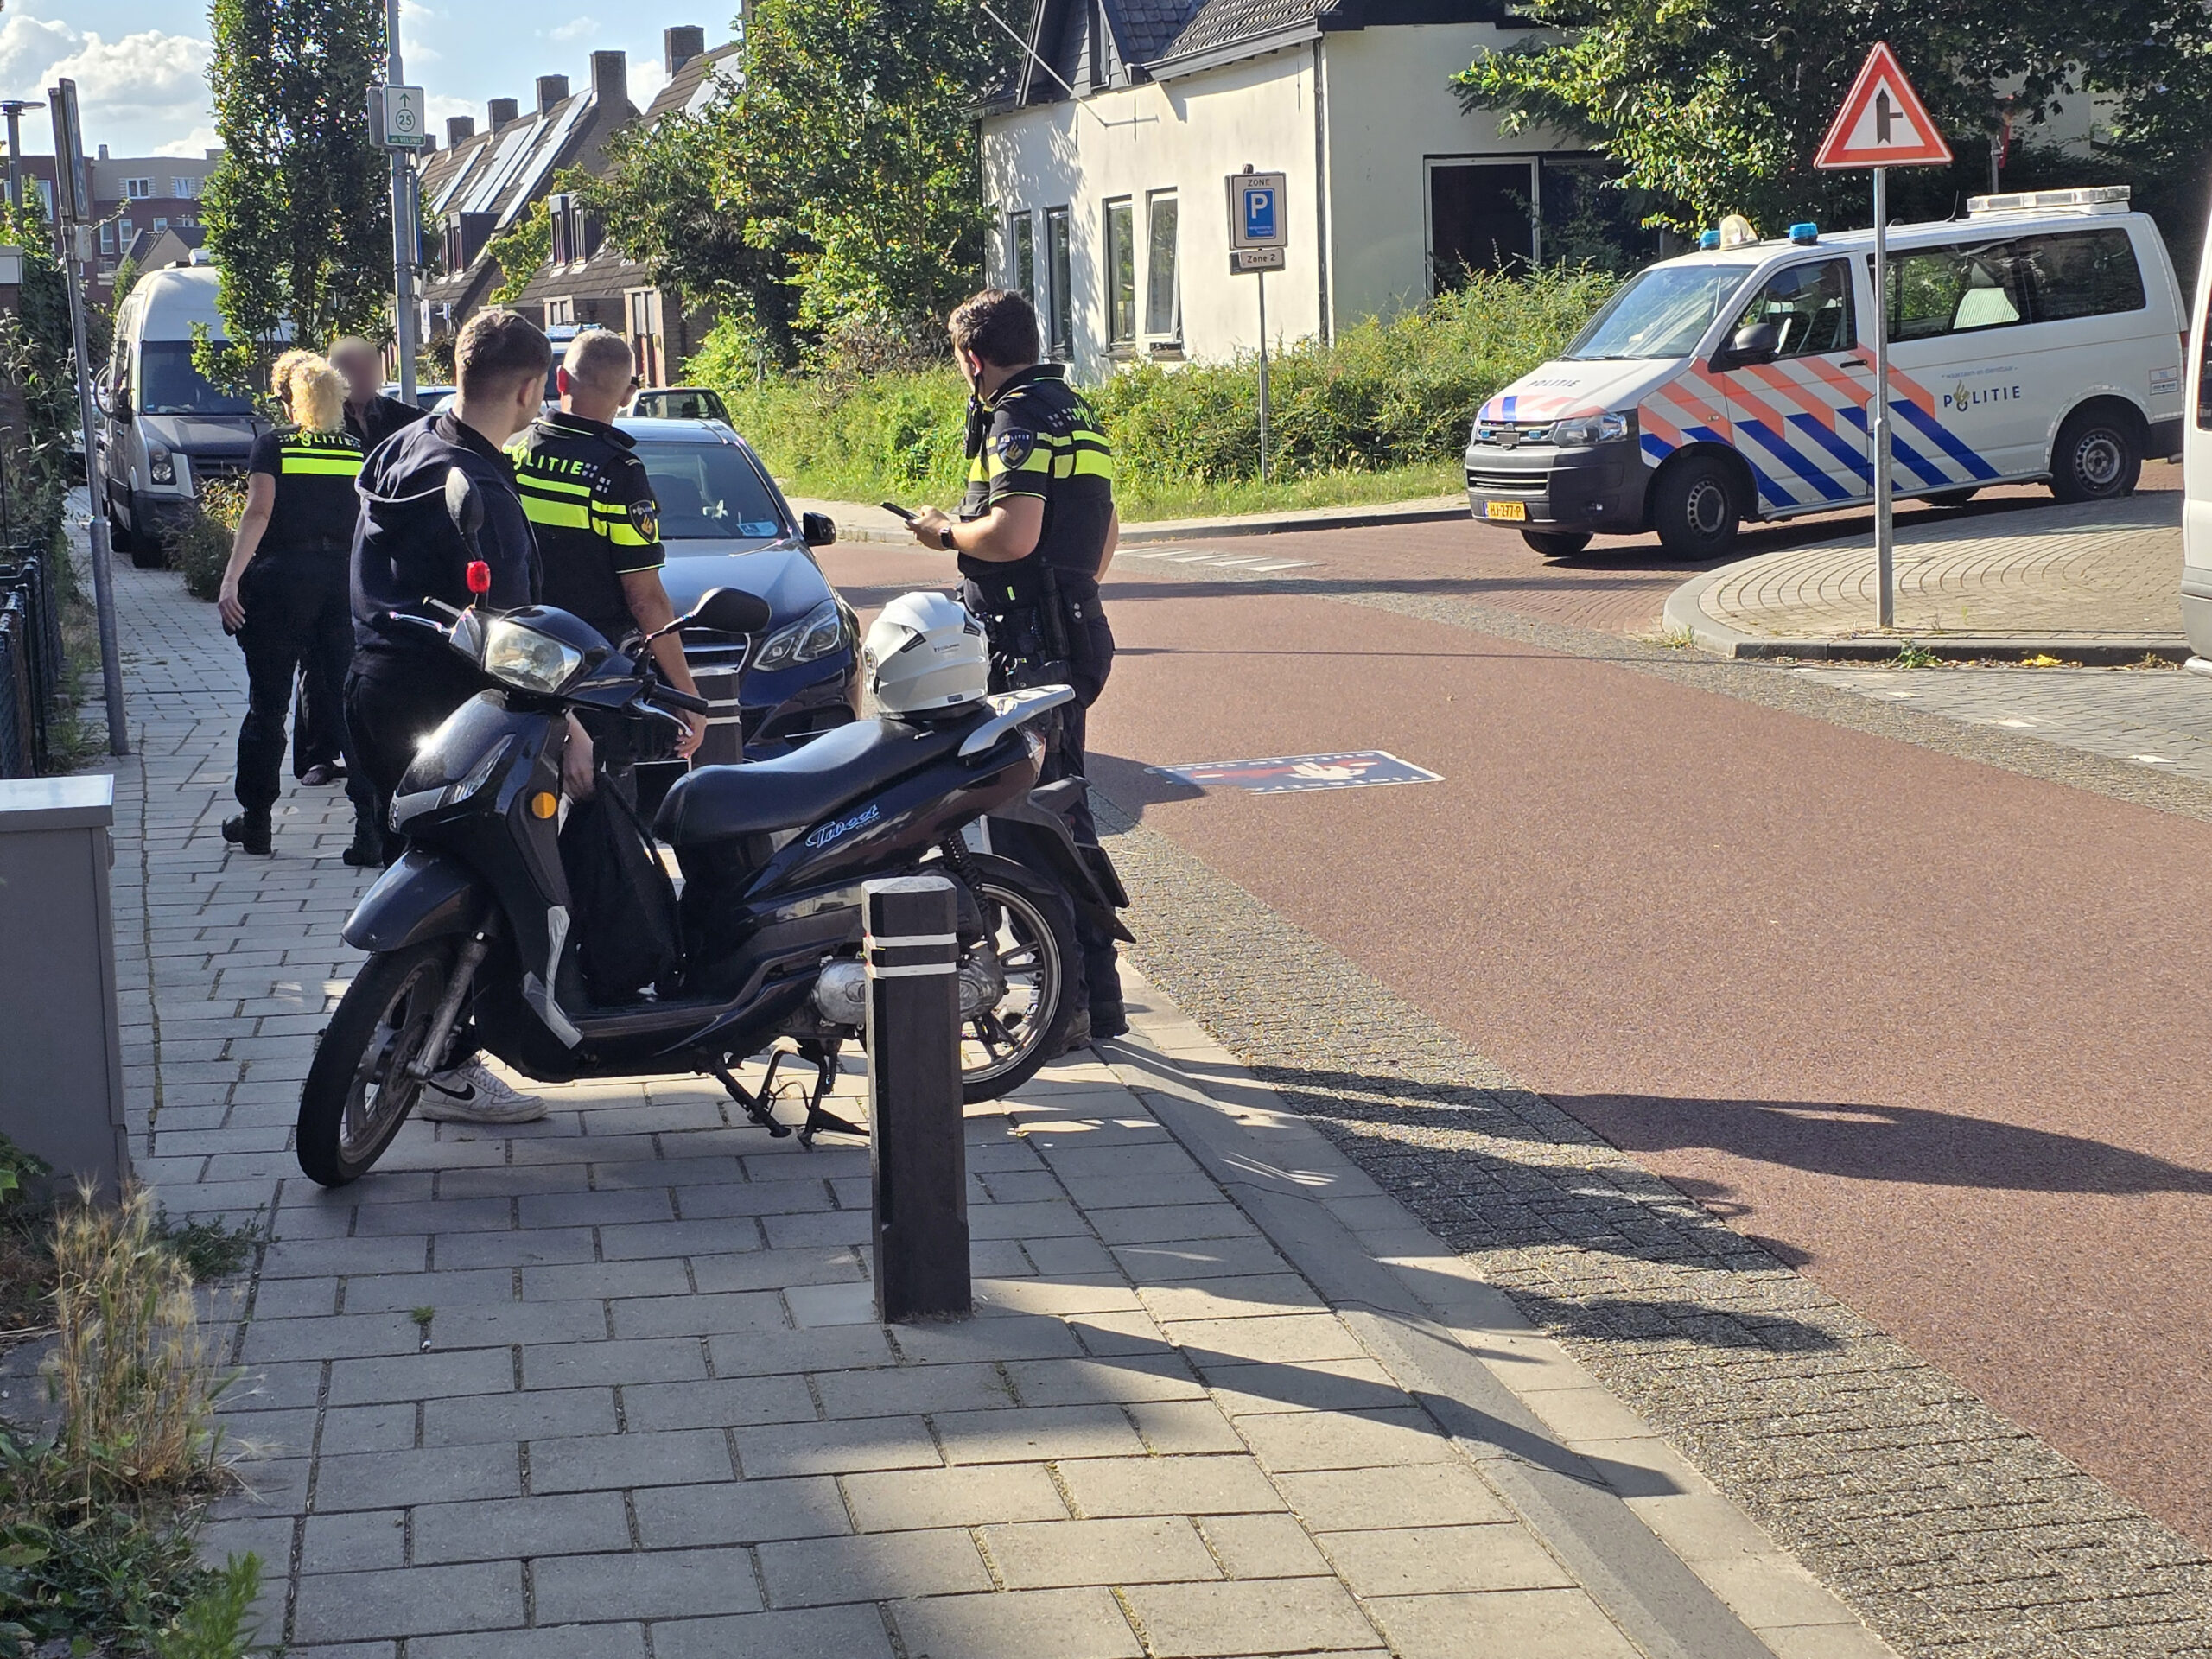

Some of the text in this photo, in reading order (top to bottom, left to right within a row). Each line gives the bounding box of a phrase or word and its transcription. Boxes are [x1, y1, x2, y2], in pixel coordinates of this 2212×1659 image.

[398, 114, 412, 125] 25
[1247, 178, 1272, 187] ZONE
[1250, 193, 1268, 219] P
[1247, 253, 1276, 264] Zone 2
[1527, 379, 1580, 388] POLITIE
[1943, 383, 2021, 412] POLITIE
[289, 432, 353, 447] POLITIE
[1489, 505, 1522, 515] HJ-277-P
[805, 804, 880, 849] Tweet
